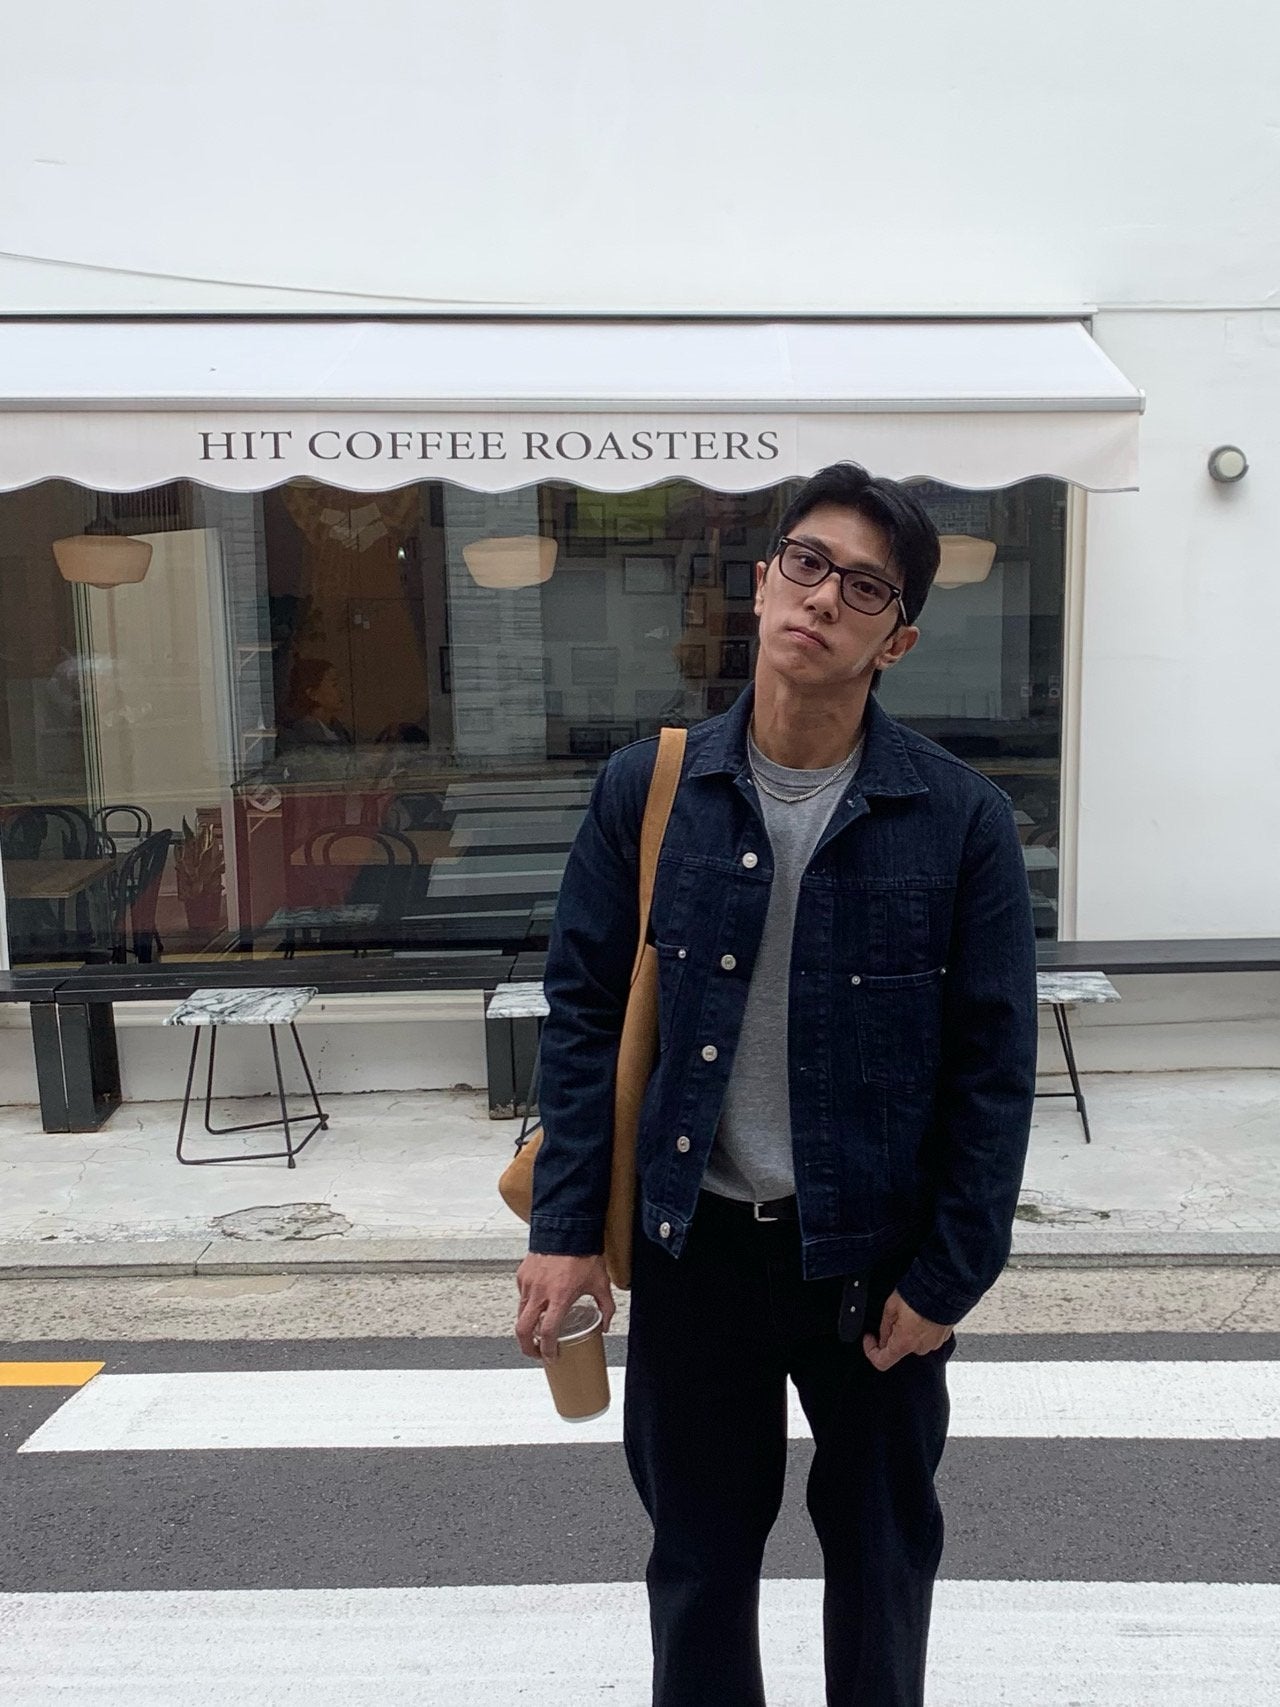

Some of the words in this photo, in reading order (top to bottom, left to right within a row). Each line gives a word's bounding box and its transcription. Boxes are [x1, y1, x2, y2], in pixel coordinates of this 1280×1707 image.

[198, 430, 292, 460] HIT
[308, 430, 507, 460] COFFEE
[521, 430, 780, 461] ROASTERS
